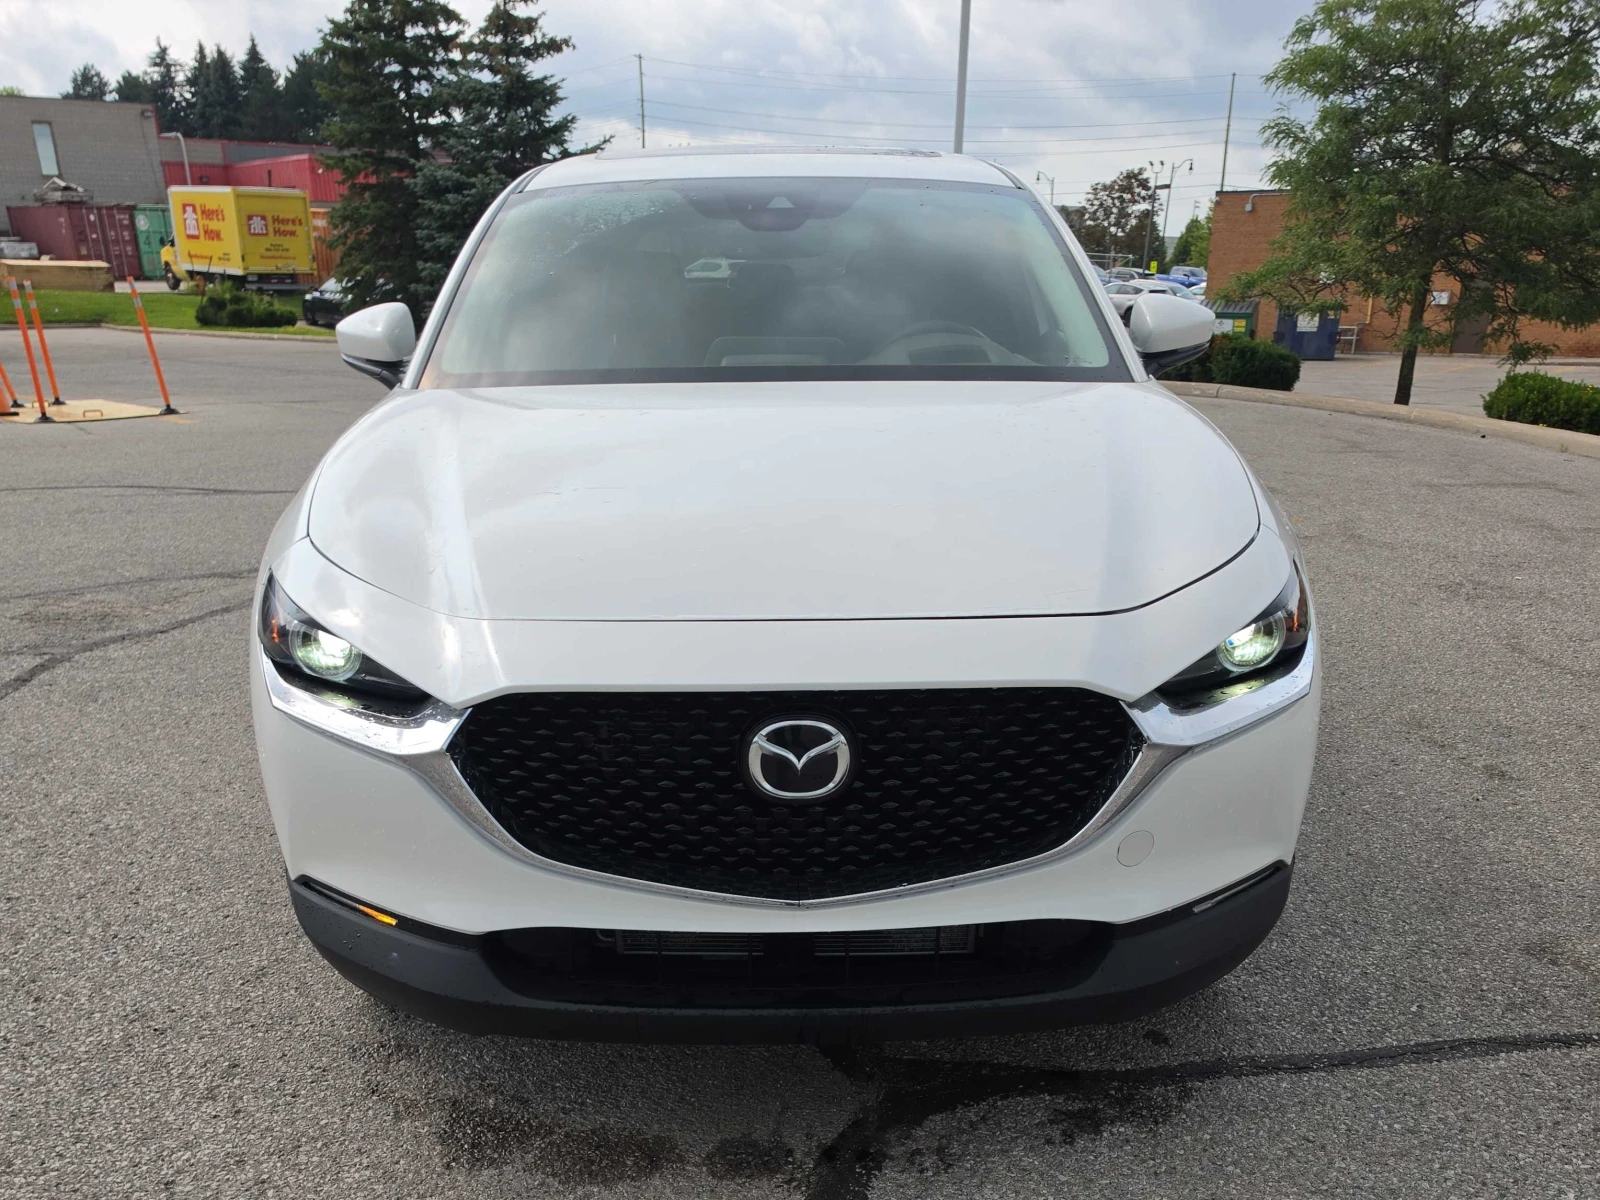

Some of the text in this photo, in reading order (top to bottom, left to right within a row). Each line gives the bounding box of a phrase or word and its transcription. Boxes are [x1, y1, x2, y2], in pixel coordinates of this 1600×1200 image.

[200, 204, 225, 222] Here's
[271, 215, 302, 227] Here's
[273, 227, 299, 238] How.
[143, 234, 151, 248] 4
